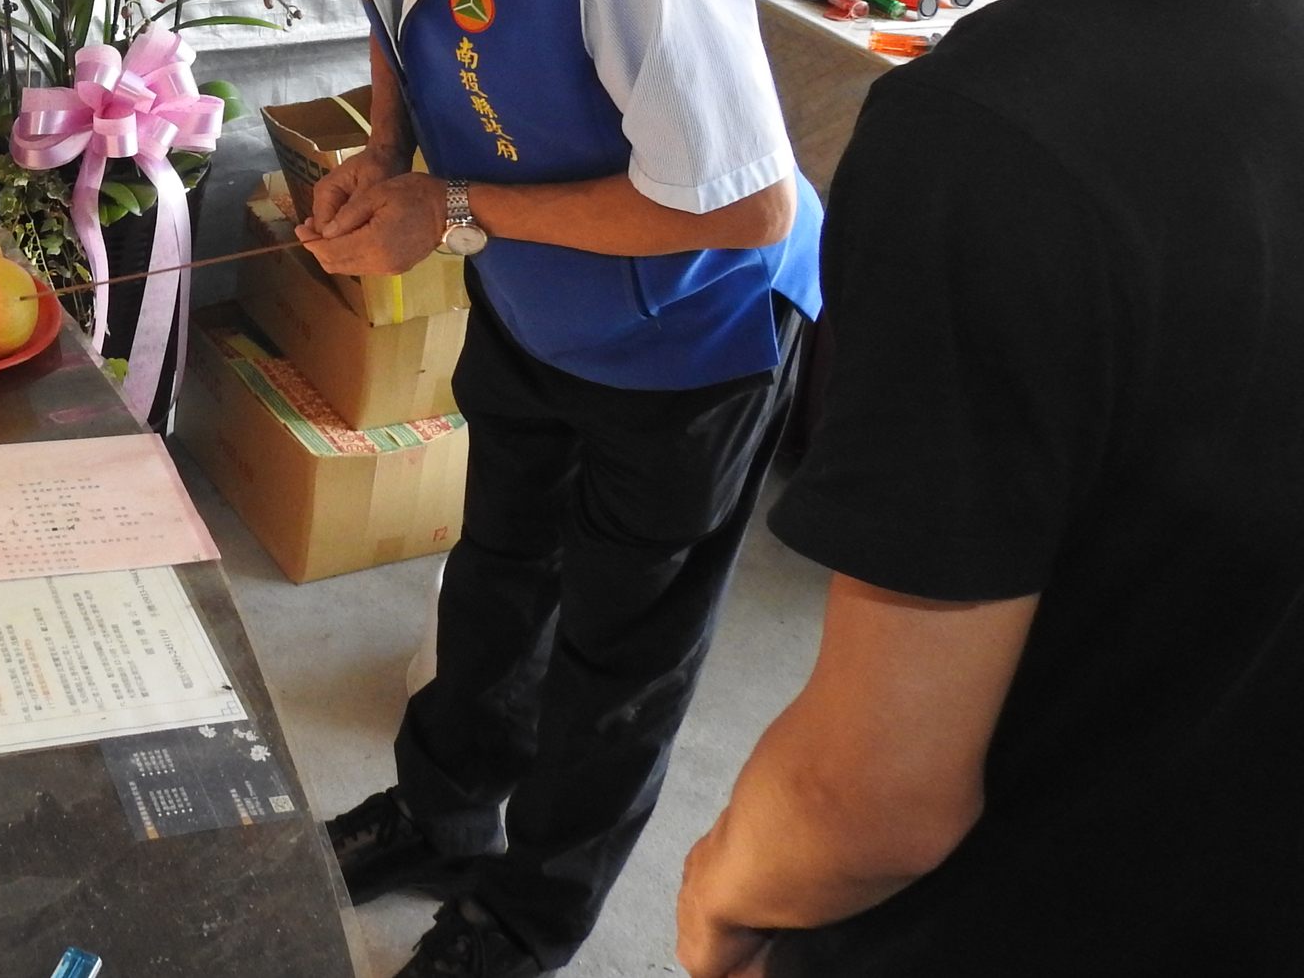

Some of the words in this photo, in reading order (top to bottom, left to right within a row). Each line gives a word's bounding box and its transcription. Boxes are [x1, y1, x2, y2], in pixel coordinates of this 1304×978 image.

[456, 36, 518, 162] 南投縣政府
